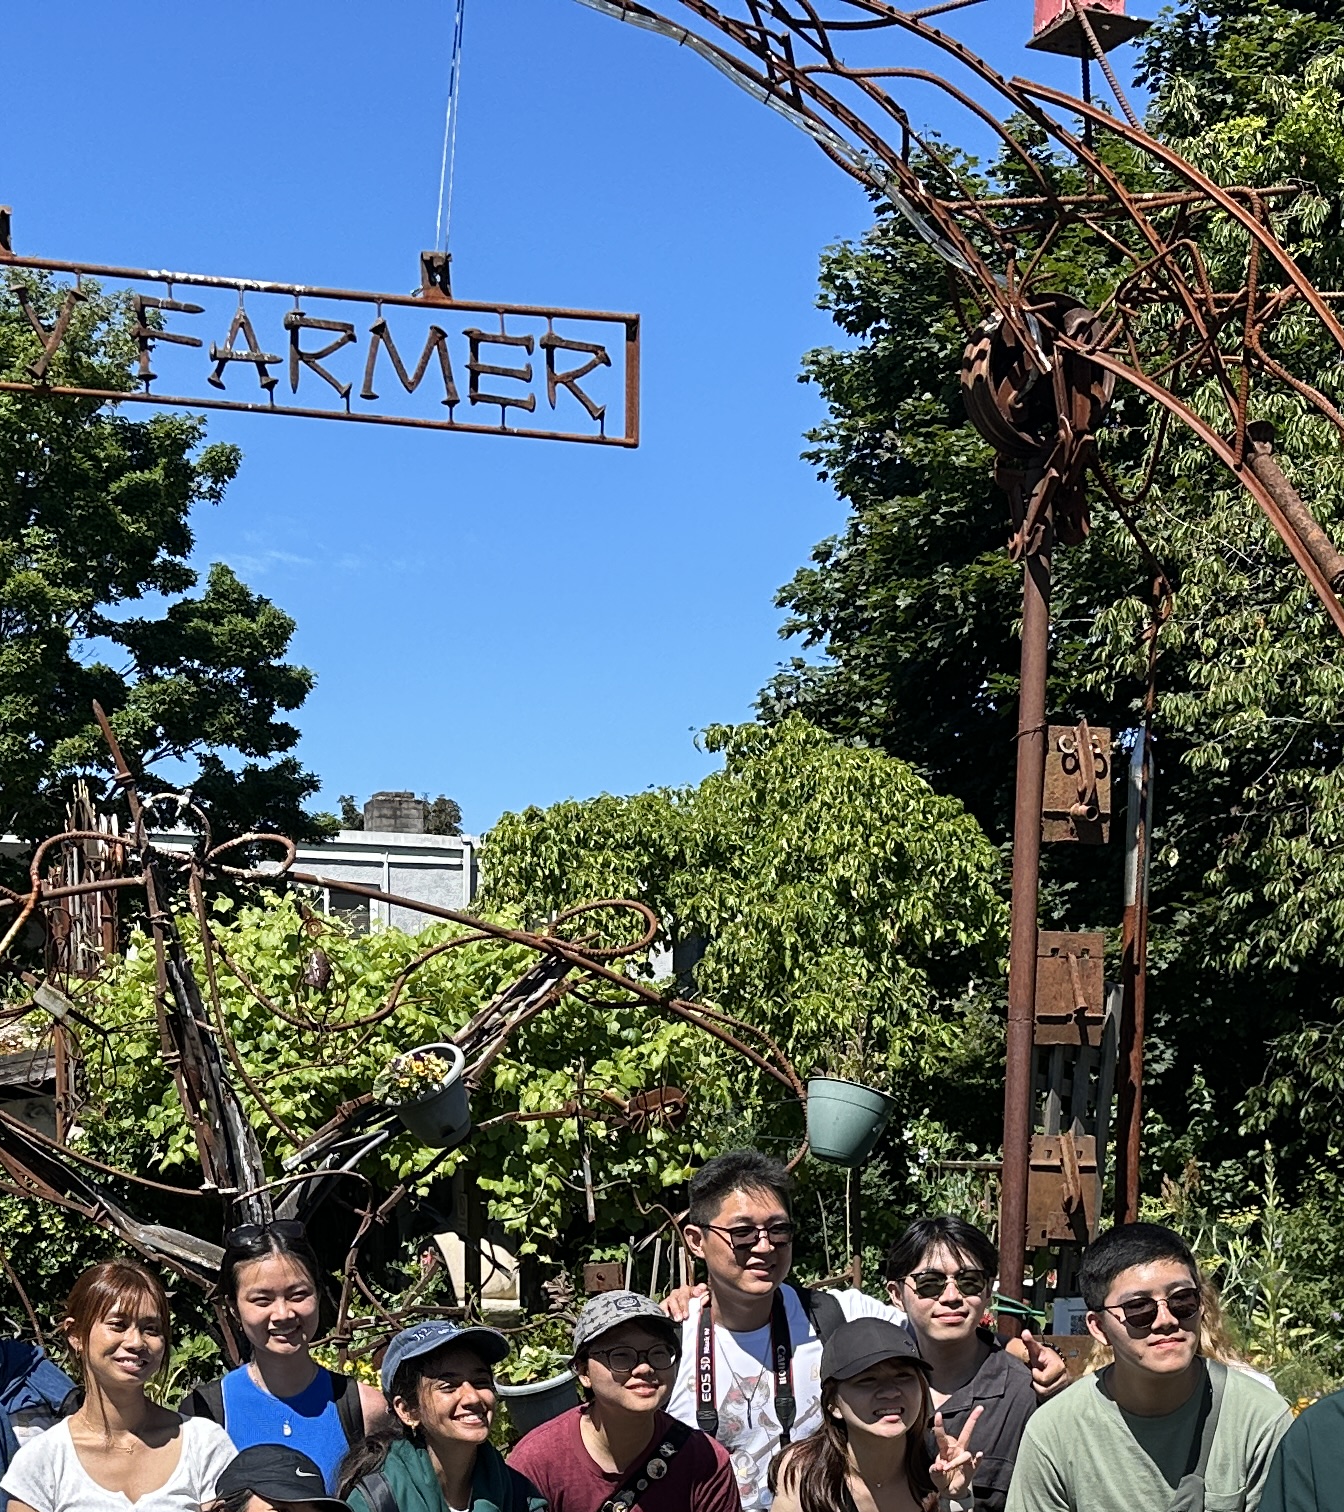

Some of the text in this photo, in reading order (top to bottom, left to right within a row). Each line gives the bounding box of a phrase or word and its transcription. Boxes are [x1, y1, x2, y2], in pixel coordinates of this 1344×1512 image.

[132, 293, 613, 420] FARMER
[776, 1344, 787, 1385] Canon
[701, 1374, 712, 1402] EOS
